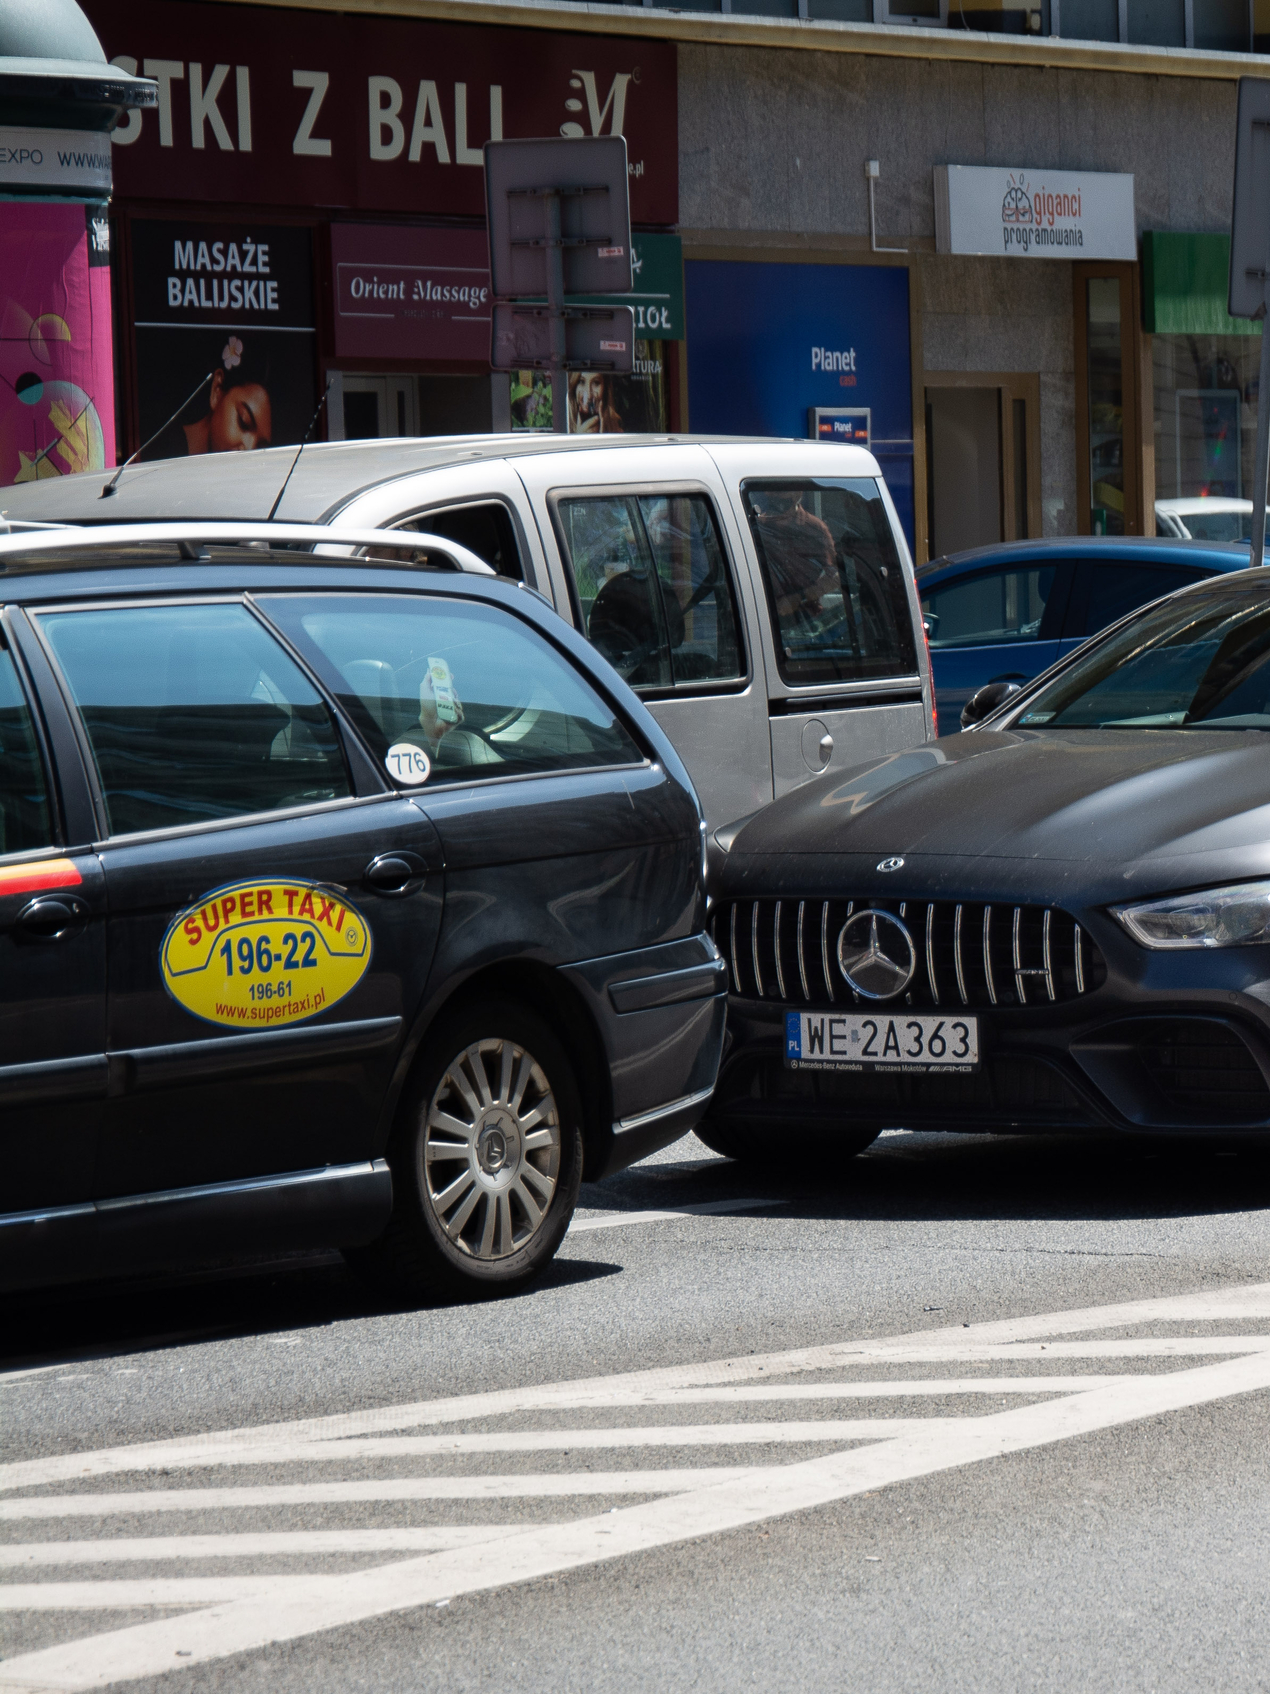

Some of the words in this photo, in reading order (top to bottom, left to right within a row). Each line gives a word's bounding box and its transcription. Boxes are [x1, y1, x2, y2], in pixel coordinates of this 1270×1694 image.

[292, 70, 333, 157] Z
[1033, 185, 1082, 226] giganci
[1003, 224, 1083, 251] programowania
[174, 236, 270, 273] MASAŻE
[167, 276, 279, 310] BALIJSKIE
[350, 276, 405, 299] Orient
[412, 279, 488, 309] Massage
[811, 346, 856, 371] Planet
[389, 749, 428, 777] 776
[183, 889, 274, 946] SUPER
[283, 889, 346, 933] TAXI
[220, 930, 318, 977] 196-22
[215, 987, 326, 1023] www.supertaxi.pl
[249, 980, 292, 1001] 196-61
[788, 1040, 800, 1051] PL
[806, 1017, 847, 1056] WE
[861, 1019, 970, 1058] 2A363
[799, 1060, 835, 1070] Mercedes-Benz
[874, 1063, 902, 1072] Warszawa
